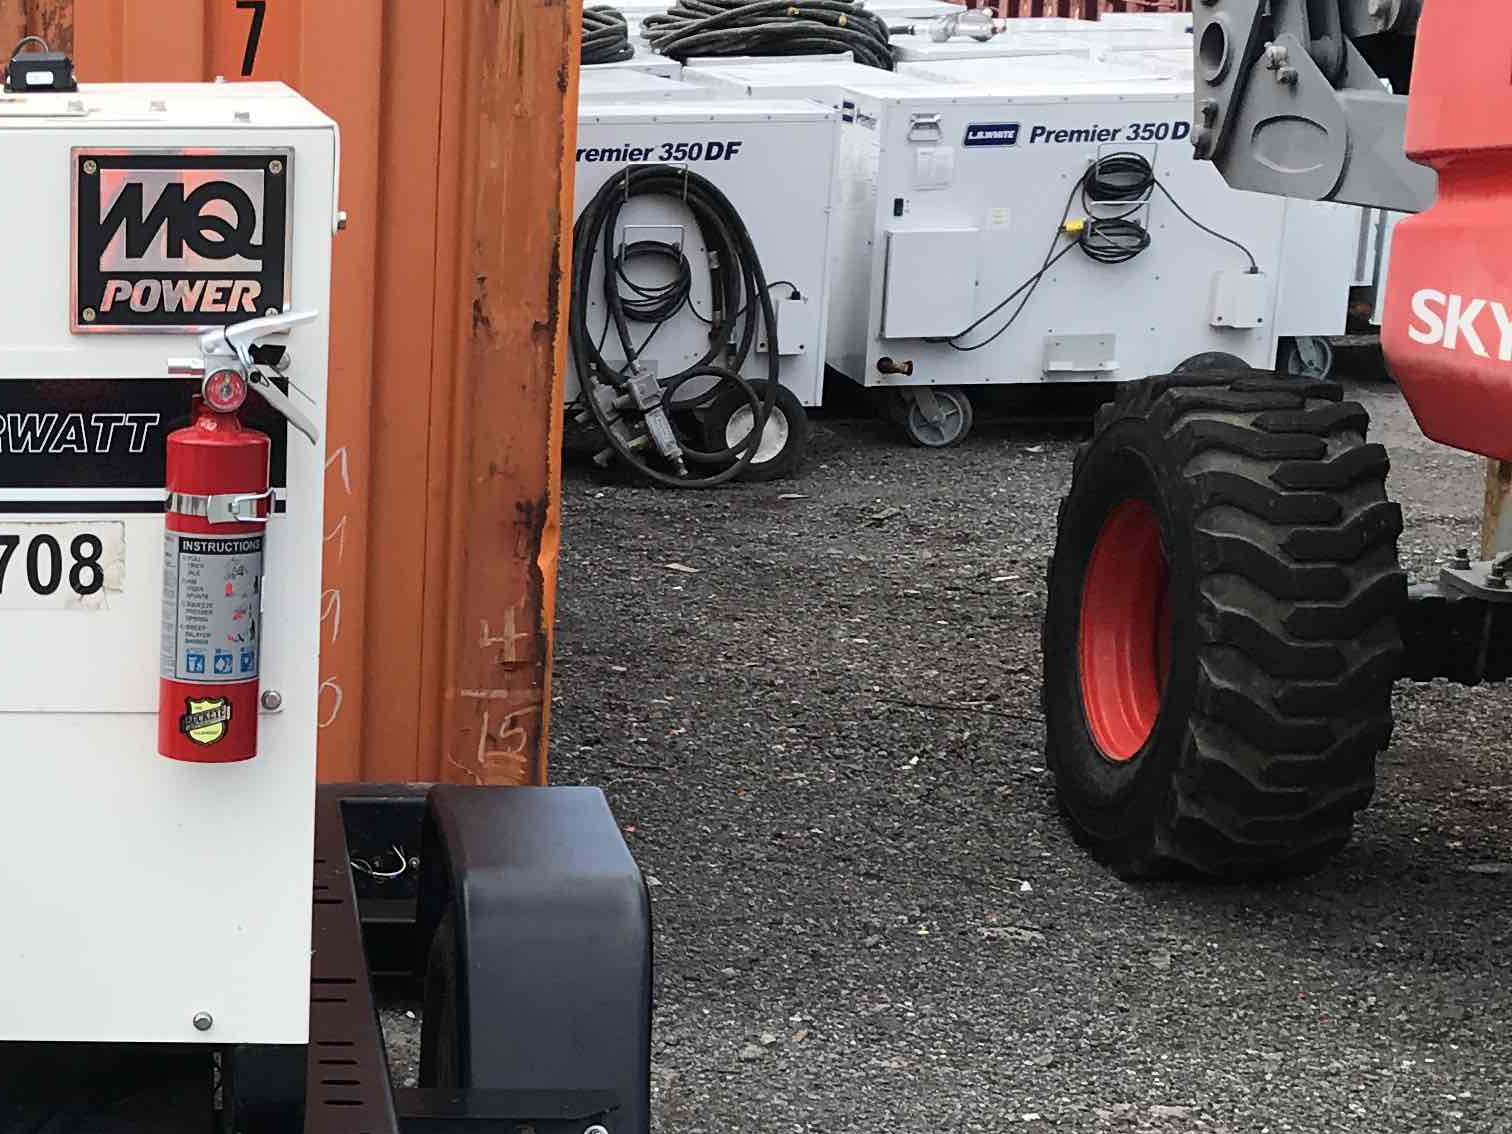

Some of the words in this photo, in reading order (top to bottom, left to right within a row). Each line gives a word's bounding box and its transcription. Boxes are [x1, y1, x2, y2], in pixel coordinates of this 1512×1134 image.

[236, 0, 266, 76] 7
[1029, 124, 1122, 144] Premier
[575, 143, 654, 163] remier
[97, 180, 263, 260] MQ
[99, 278, 263, 313] POWER
[182, 540, 261, 553] INSTRUCTIONS
